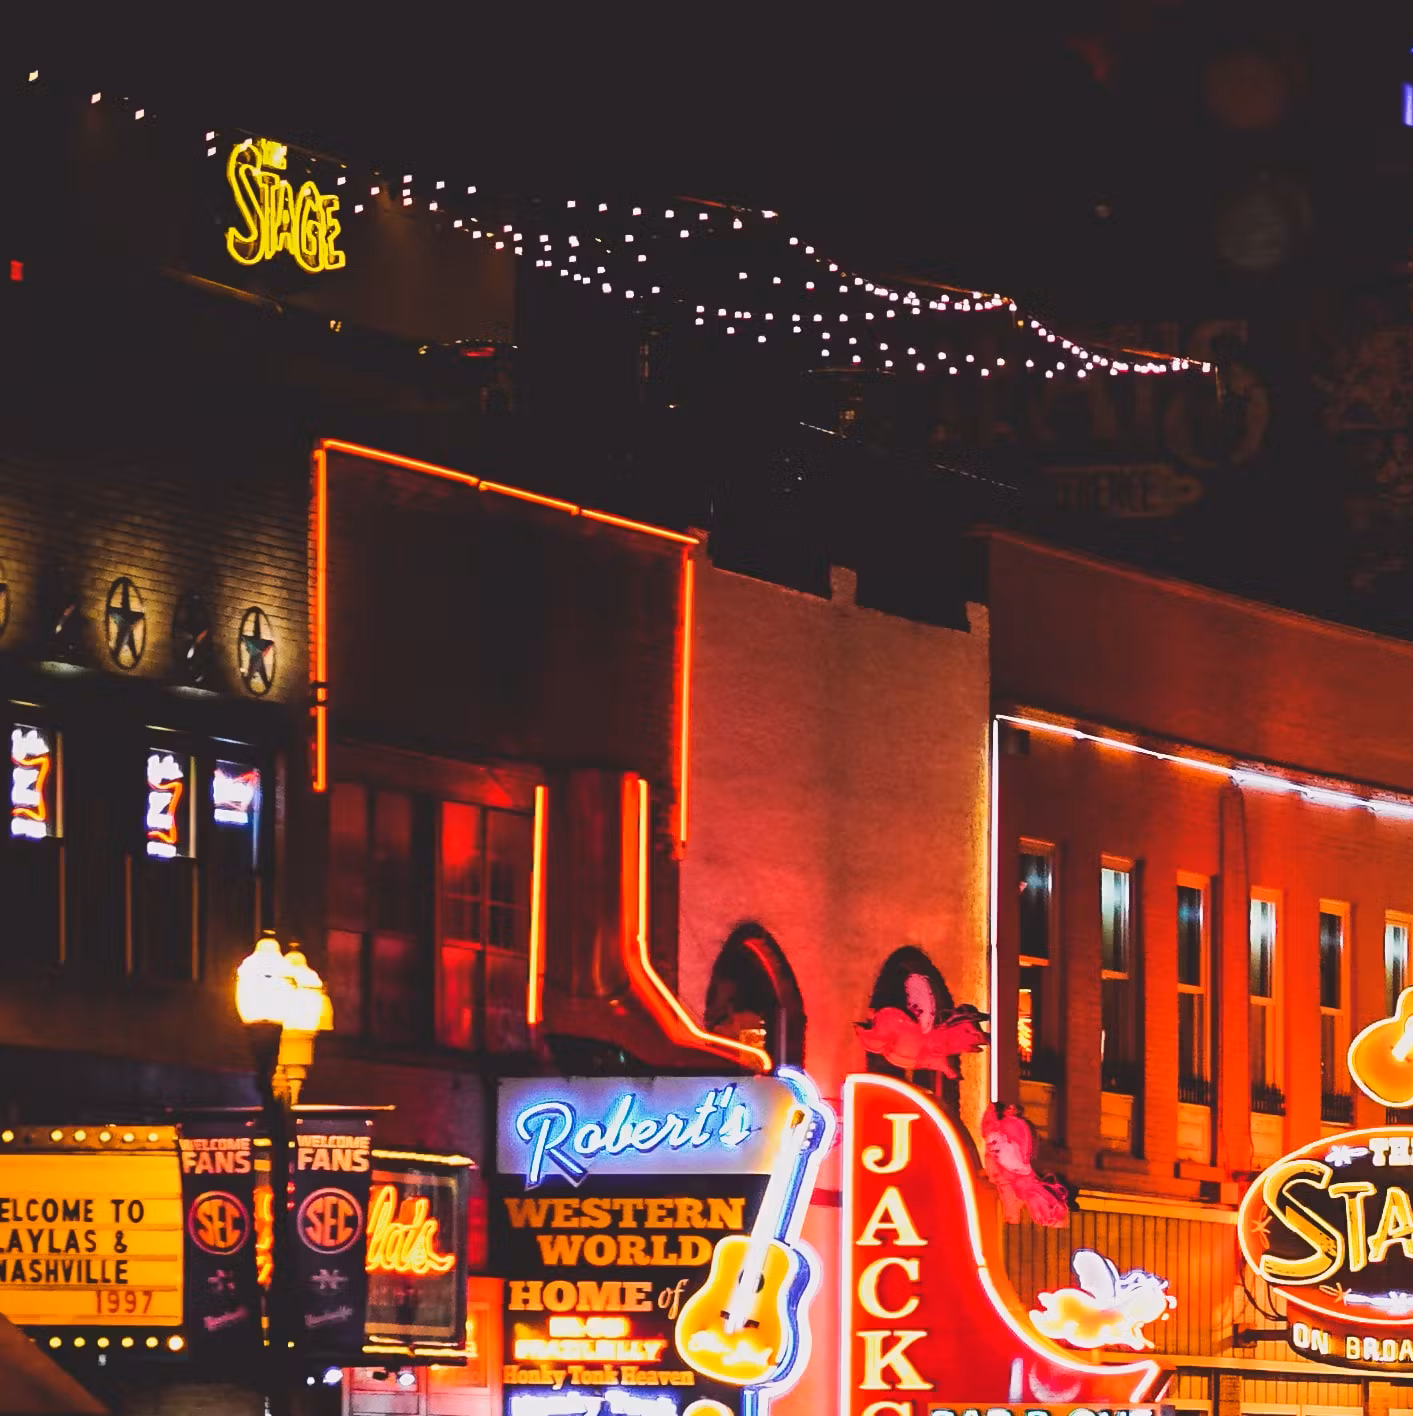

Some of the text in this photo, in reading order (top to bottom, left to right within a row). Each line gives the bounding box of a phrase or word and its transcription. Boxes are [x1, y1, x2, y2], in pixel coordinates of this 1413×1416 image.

[226, 141, 346, 273] STAGE
[178, 1138, 251, 1150] WELCOME
[297, 1134, 372, 1148] WELCOME
[514, 1083, 753, 1190] Robert's
[182, 1150, 251, 1174] FANS
[297, 1148, 370, 1172] FANS
[111, 1199, 144, 1223] TO
[196, 1199, 241, 1249] SEC
[305, 1195, 354, 1248] SEC
[503, 1197, 745, 1230] WESTERN
[0, 1228, 128, 1253] AYLAS &
[538, 1235, 713, 1267] WORLD
[95, 1290, 153, 1314] 1997
[508, 1279, 690, 1320] HOME of
[1293, 1323, 1329, 1355] ON
[503, 1365, 696, 1390] Honky Tonk Heaven
